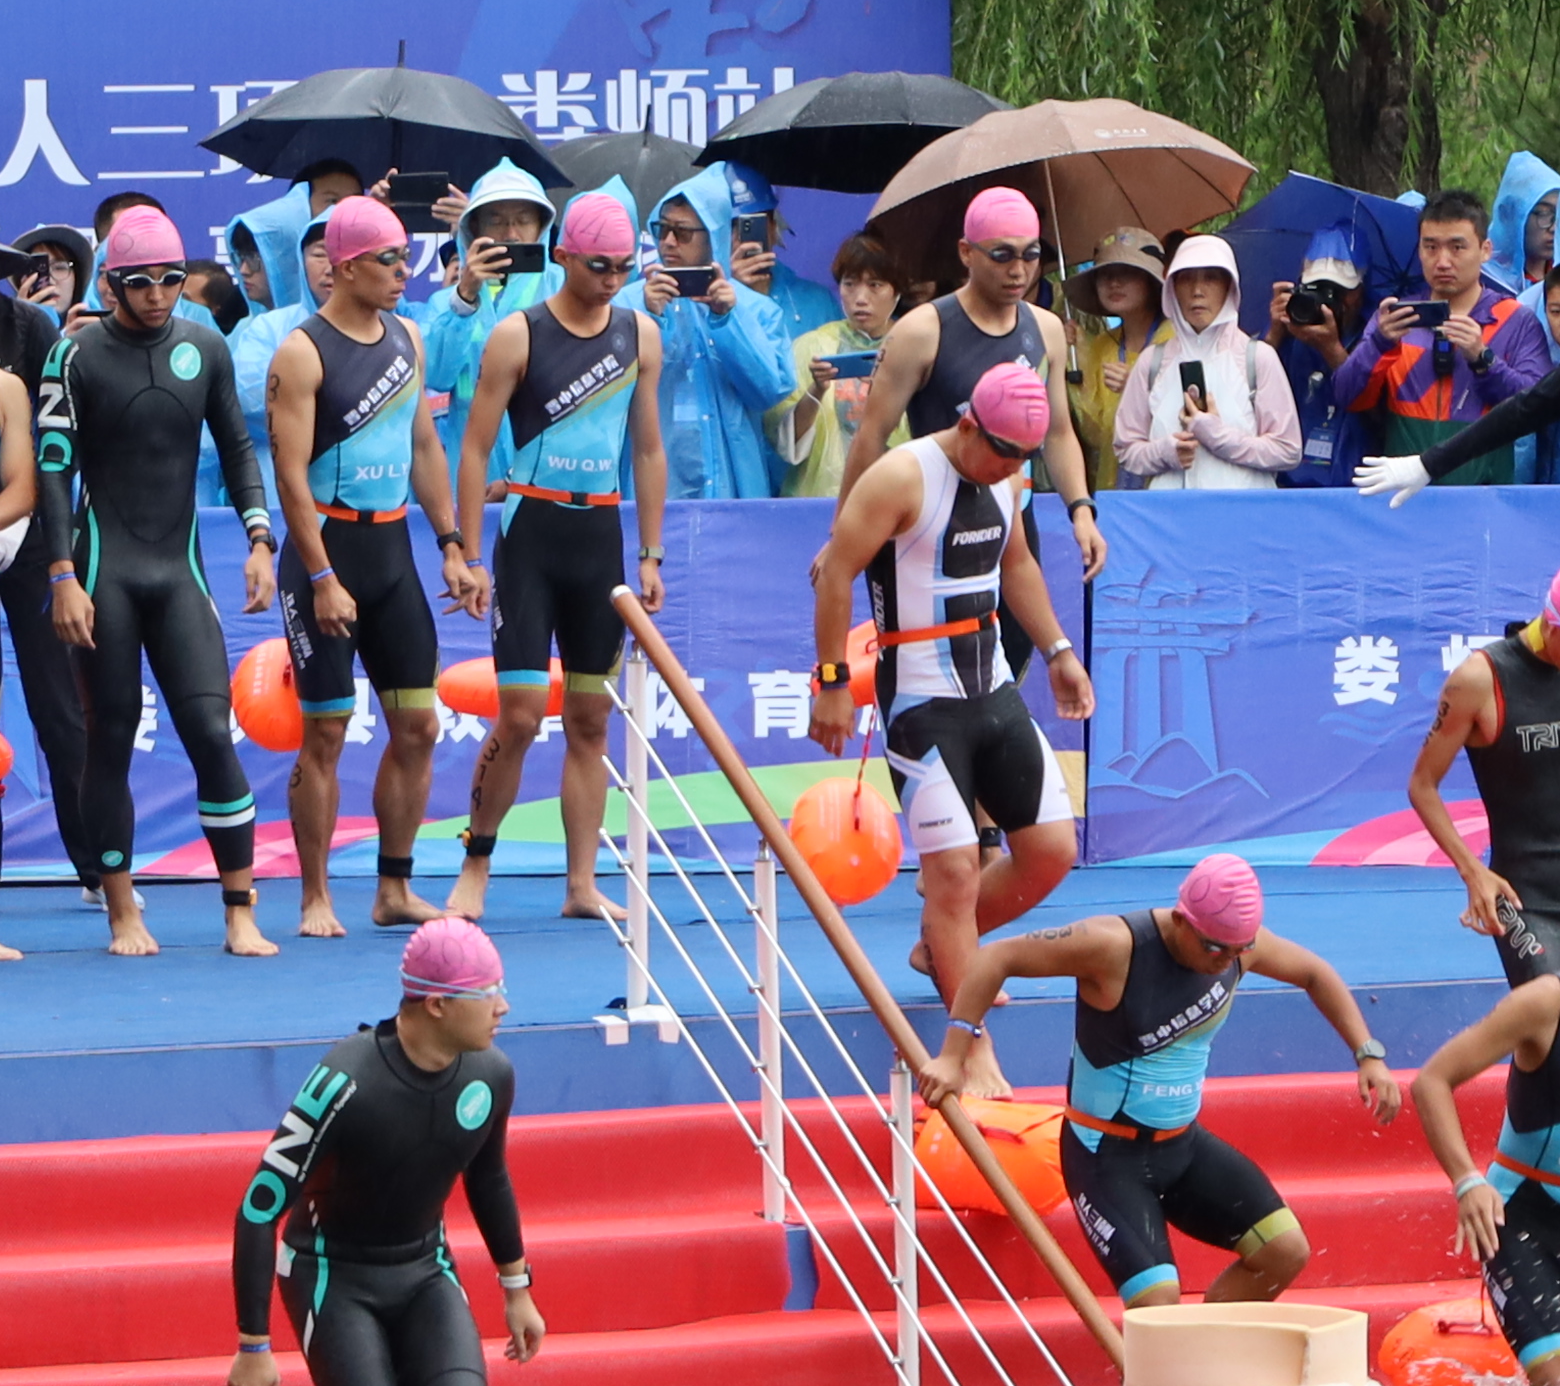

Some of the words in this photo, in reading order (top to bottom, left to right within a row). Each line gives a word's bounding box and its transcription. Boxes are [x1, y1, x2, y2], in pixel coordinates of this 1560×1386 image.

[548, 455, 577, 471] WU
[355, 464, 384, 481] XU
[952, 525, 1002, 547] FORIDER
[1142, 1083, 1193, 1097] FENG
[242, 1062, 349, 1224] ONE
